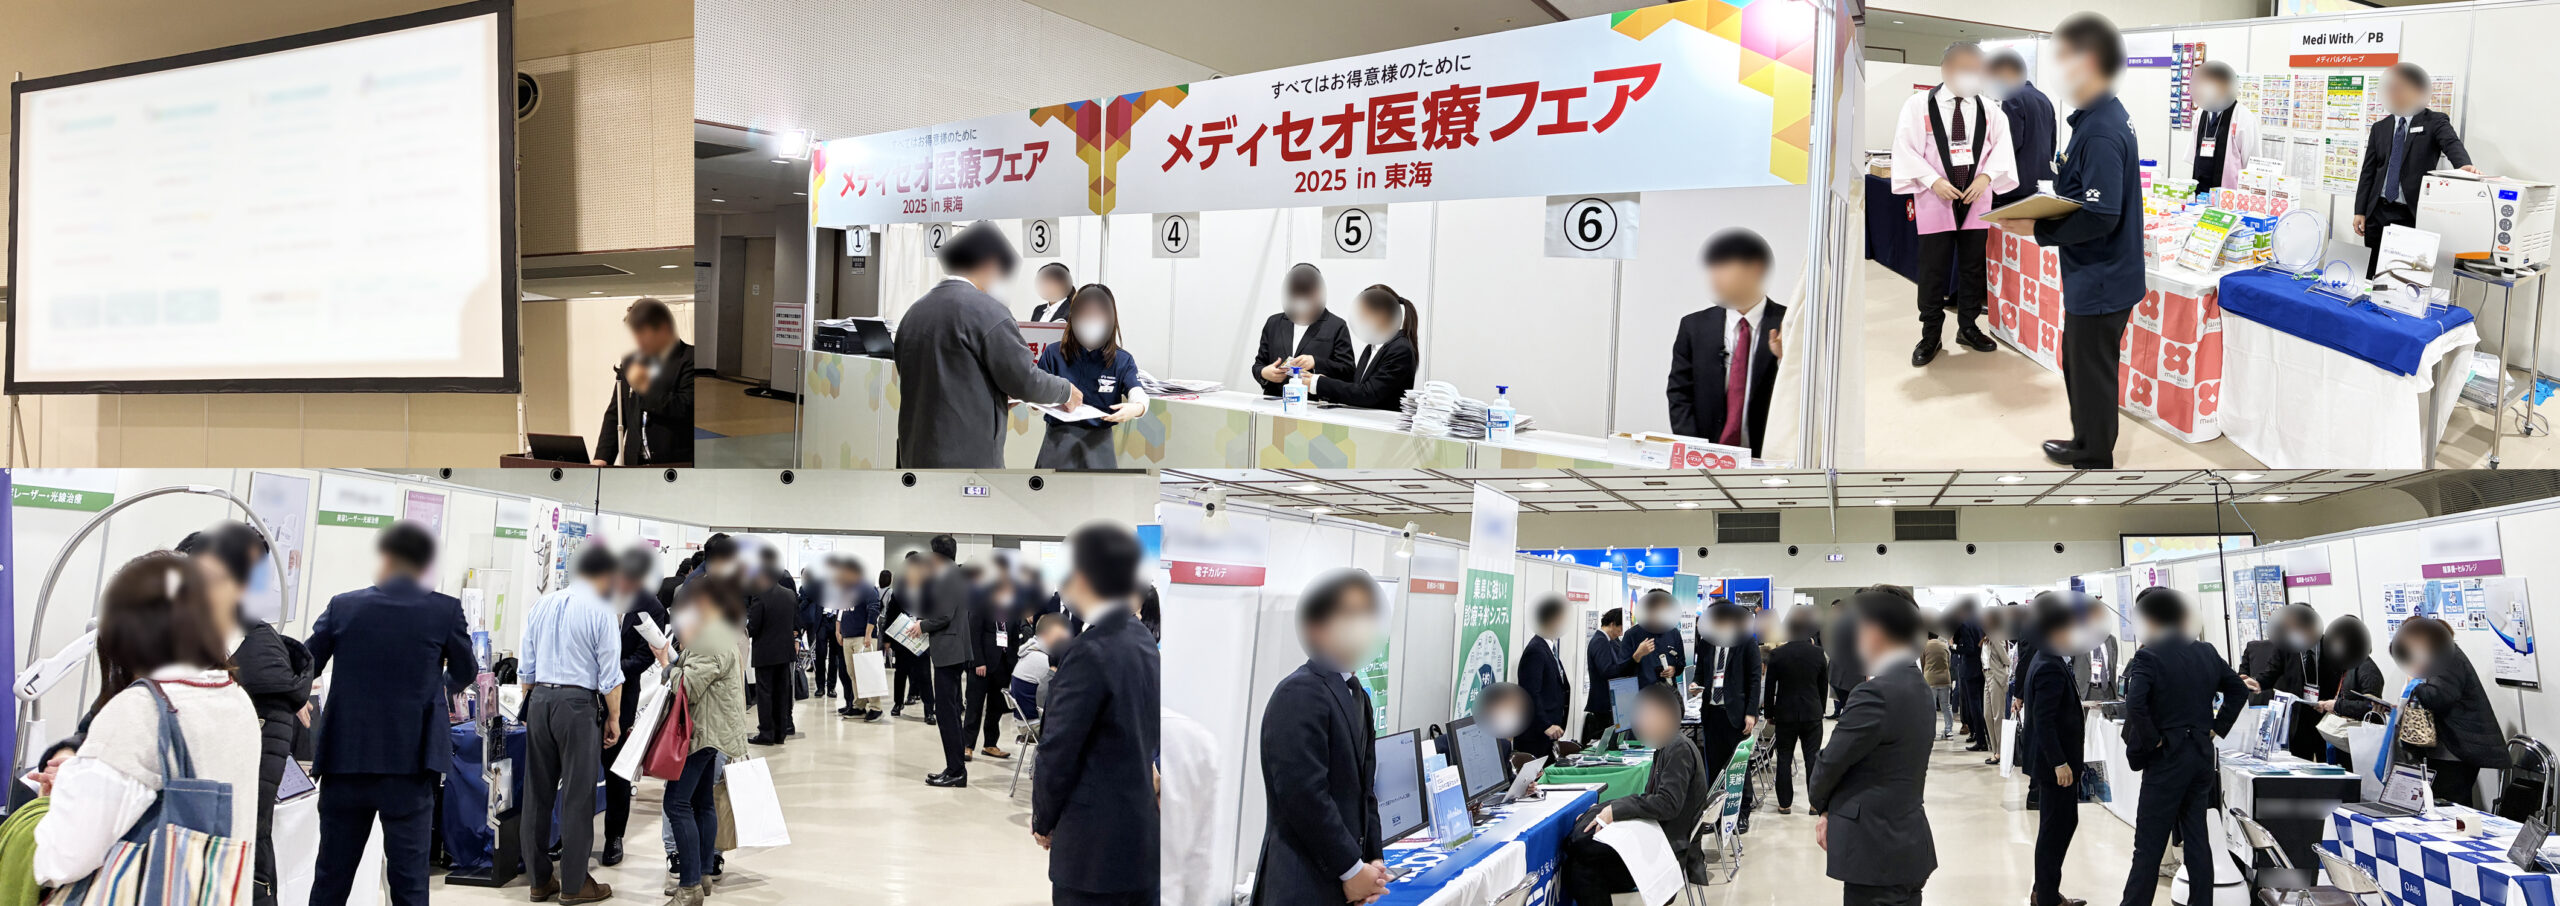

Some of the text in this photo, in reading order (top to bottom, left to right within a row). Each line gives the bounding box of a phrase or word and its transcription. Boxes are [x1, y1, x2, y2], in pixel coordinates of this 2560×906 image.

[2302, 33, 2326, 45] Medi
[1271, 54, 1472, 100] すべてはお得意様のために
[1160, 62, 1662, 173] メディセオ医療フェア
[892, 128, 977, 148] すべてはお得意様のために
[840, 140, 1050, 198] メディセオ医療フェア
[1295, 161, 1433, 194] 2025 in 東海
[903, 195, 963, 214] 2025 in 東海
[1195, 566, 1227, 578] 電子カルテ
